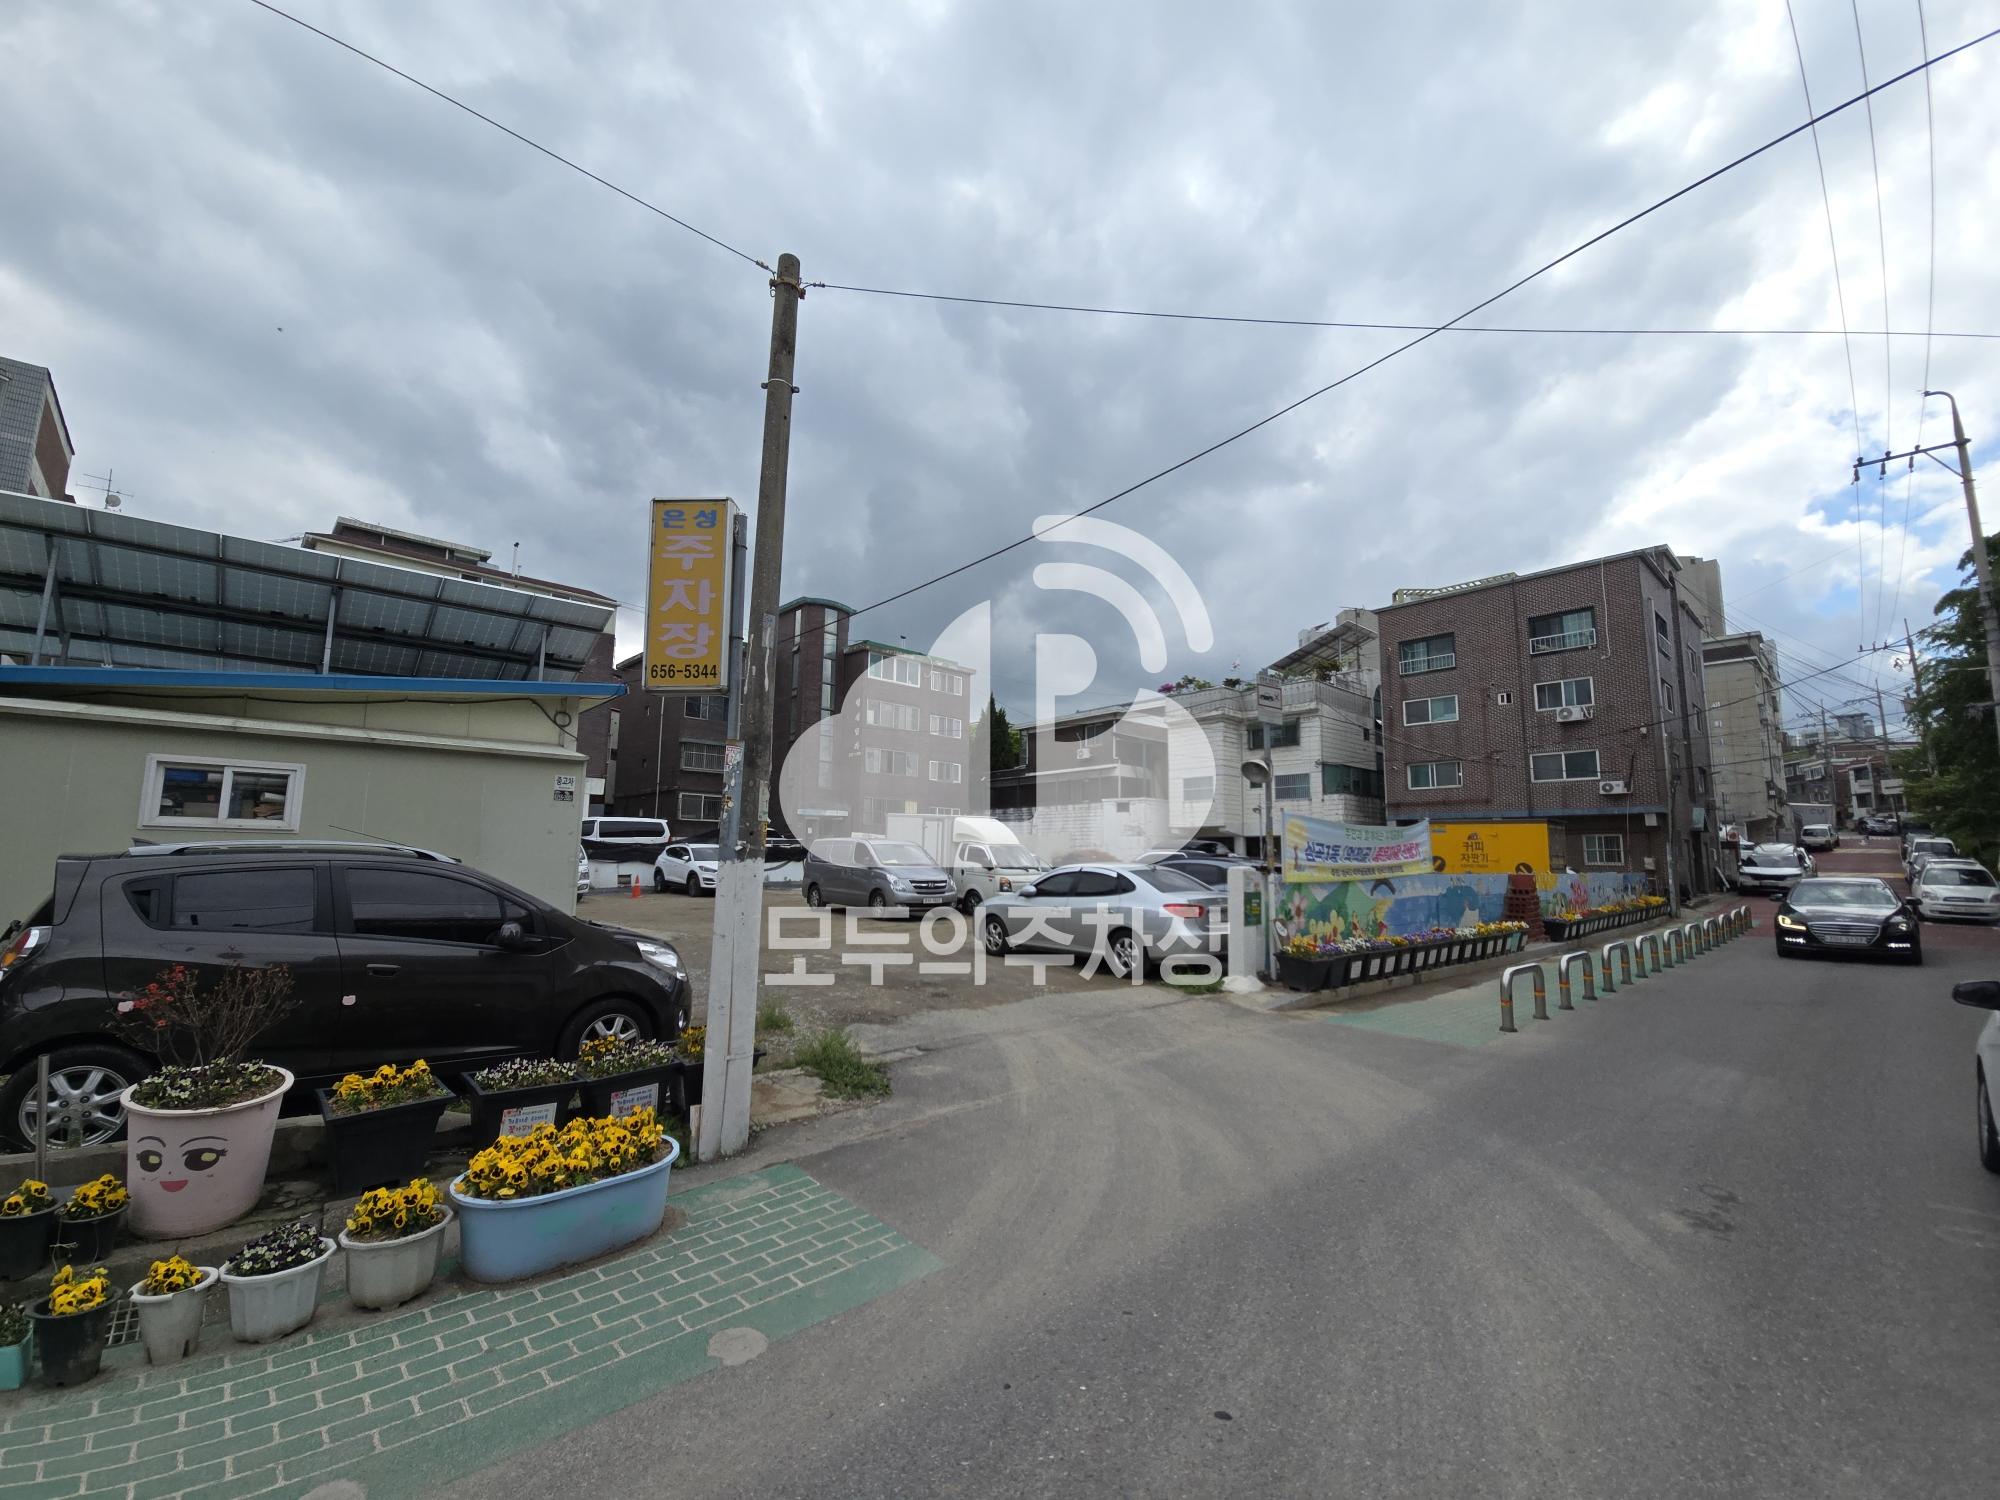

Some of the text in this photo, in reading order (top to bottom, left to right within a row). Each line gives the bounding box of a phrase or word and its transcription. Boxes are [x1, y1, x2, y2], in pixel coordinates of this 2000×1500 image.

[662, 508, 717, 529] 은성
[650, 664, 718, 680] 656-5344
[1462, 841, 1484, 853] 커피
[1460, 853, 1489, 863] 자판기
